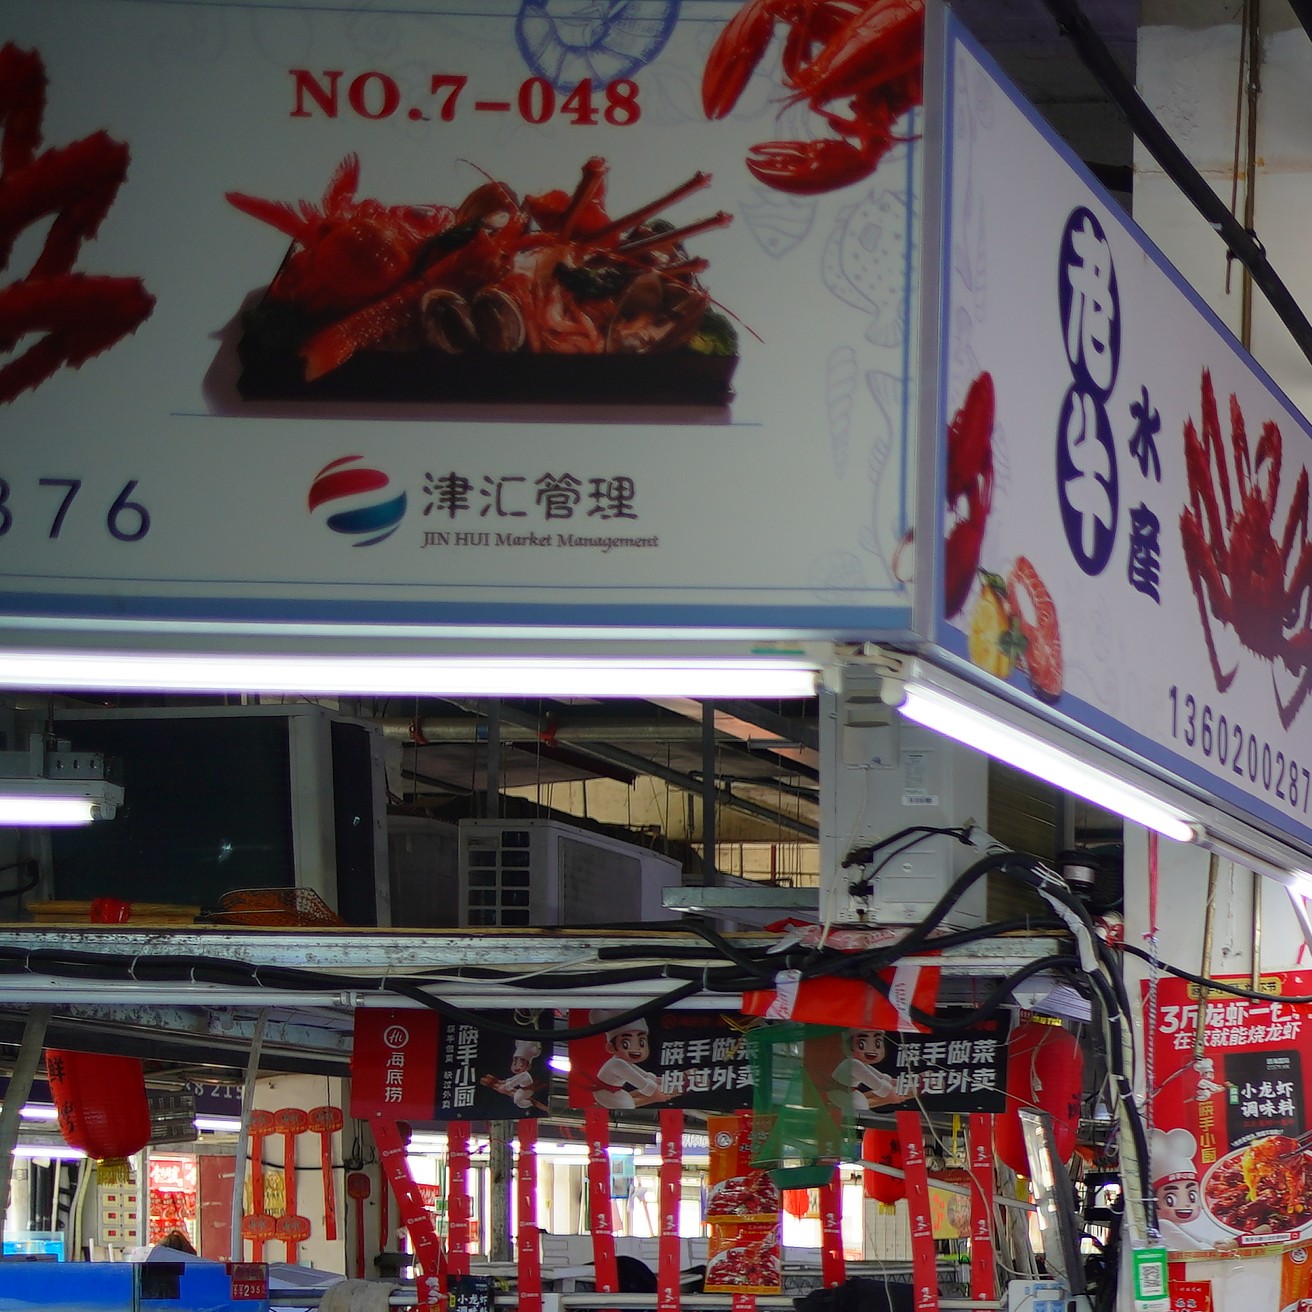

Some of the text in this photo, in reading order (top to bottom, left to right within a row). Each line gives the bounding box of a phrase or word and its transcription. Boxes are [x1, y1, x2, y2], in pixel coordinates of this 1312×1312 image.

[289, 69, 641, 127] NO.7-048
[423, 471, 638, 520] 津汇管理
[421, 531, 659, 553] JIN HUI Market Management
[896, 1039, 998, 1066] 筷手做菜
[384, 1051, 404, 1103] 海底捞
[896, 1067, 996, 1095] 快过外卖
[1241, 1081, 1294, 1099] 小龙虾
[1241, 1098, 1295, 1119] 调味料
